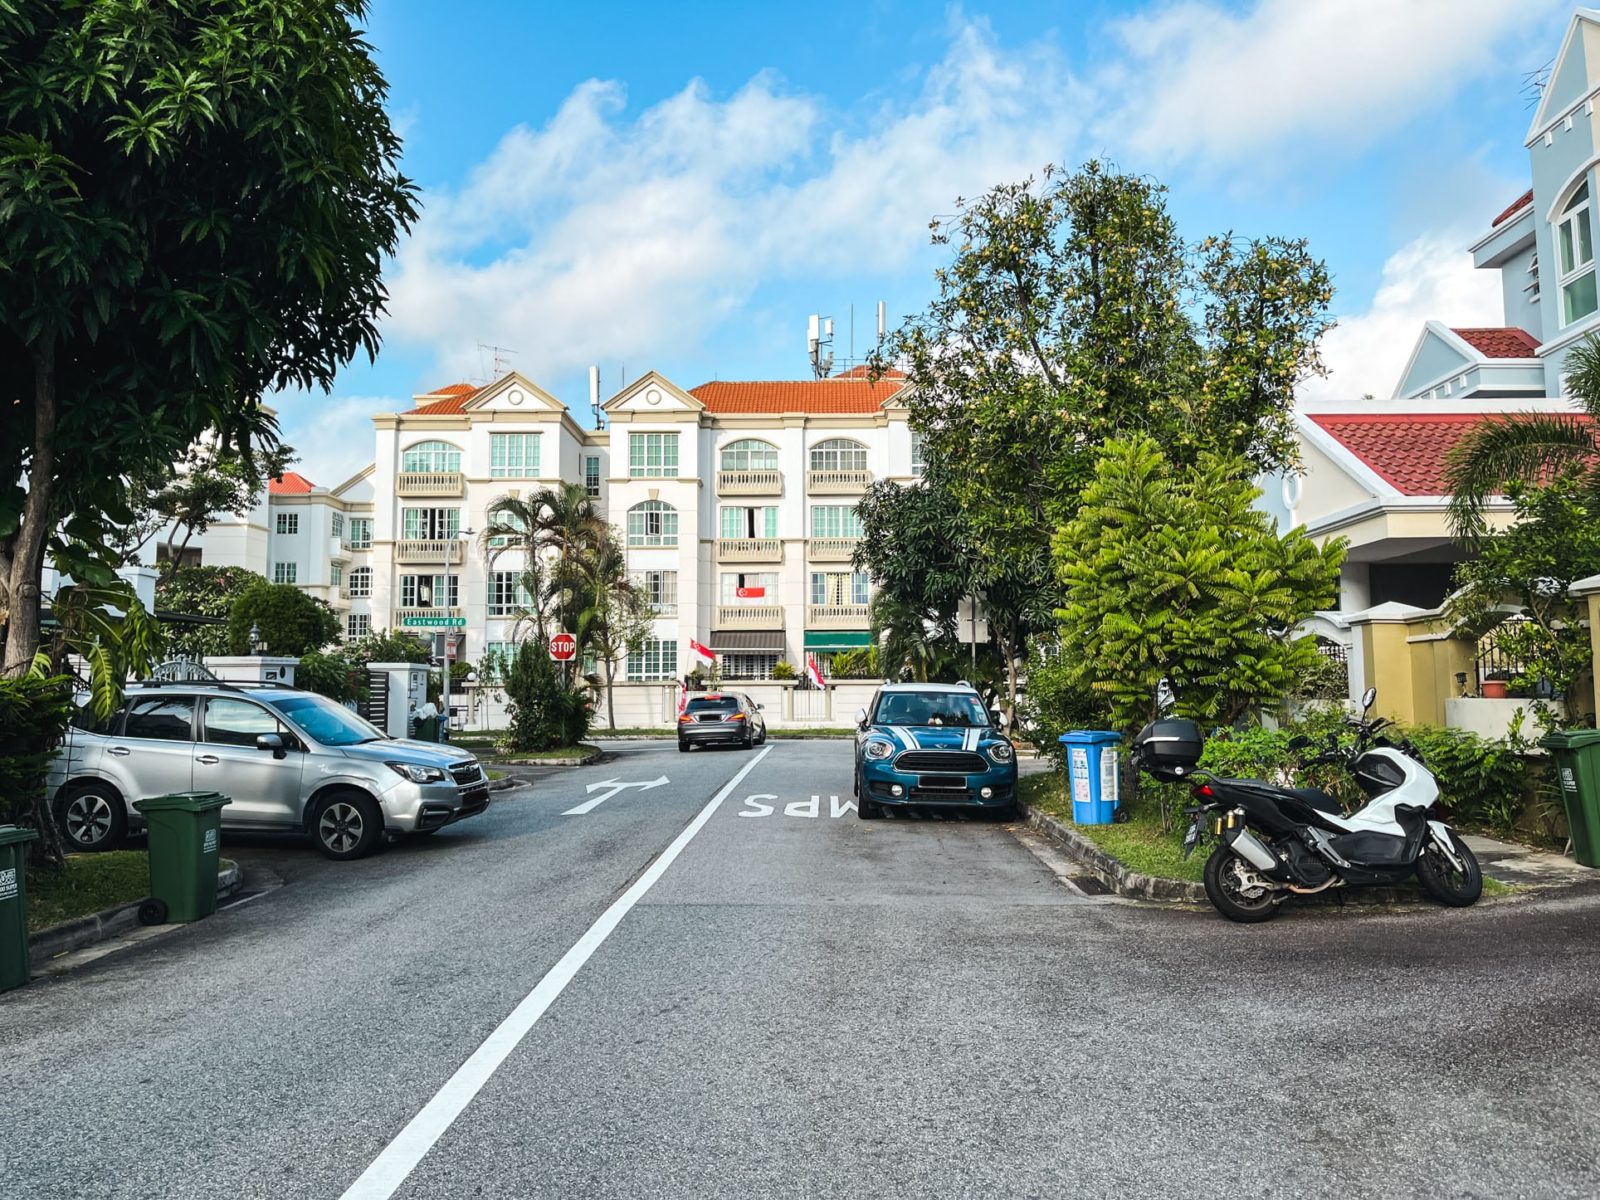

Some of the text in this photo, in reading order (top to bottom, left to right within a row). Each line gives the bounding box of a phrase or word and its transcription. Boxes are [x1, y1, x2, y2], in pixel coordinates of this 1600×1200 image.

[407, 618, 463, 626] Eastwood Rd
[551, 641, 575, 653] STOP
